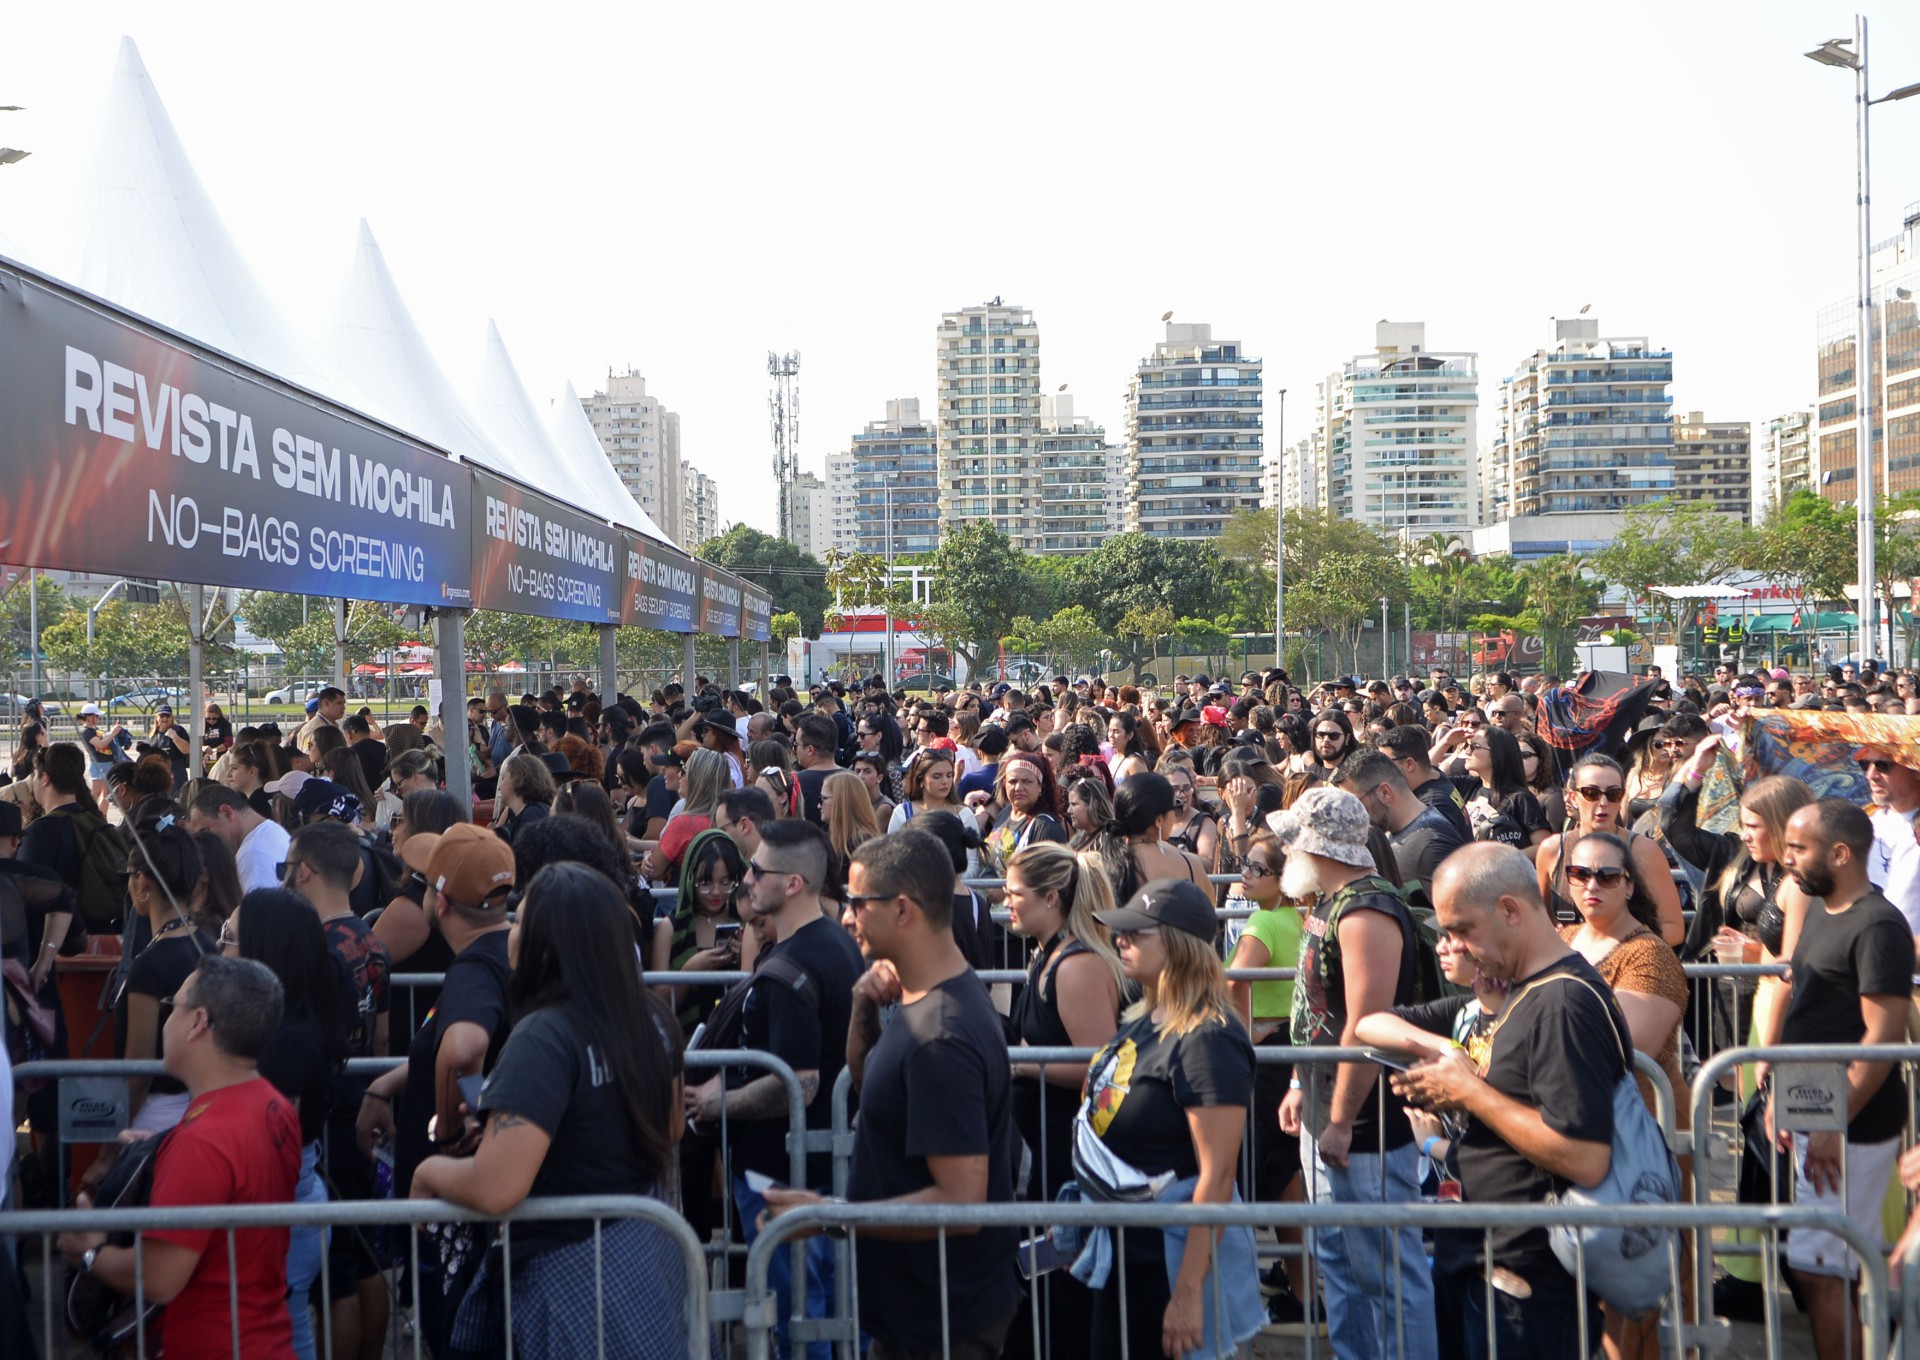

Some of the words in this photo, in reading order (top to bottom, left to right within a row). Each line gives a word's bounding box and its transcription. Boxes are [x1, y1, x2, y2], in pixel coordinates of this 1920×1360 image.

[64, 345, 260, 480] REVISTA
[272, 427, 341, 502] SEM
[349, 453, 456, 530] MOCHILA
[147, 489, 300, 566] NO-BAGS
[309, 527, 424, 582] SCREENING
[486, 495, 541, 552] REVISTA
[544, 519, 569, 560] SEM
[571, 531, 614, 574] MOCHILA
[446, 584, 471, 600] ingresso.com
[508, 562, 555, 600] NO-BAGS
[557, 578, 601, 608] SCREENING
[627, 550, 656, 585] REVISTA
[657, 561, 671, 590] COM
[671, 567, 696, 597] MOCHILA
[634, 593, 648, 613] BAGS
[648, 596, 669, 617] SECURITY
[669, 601, 691, 621] SCREENING
